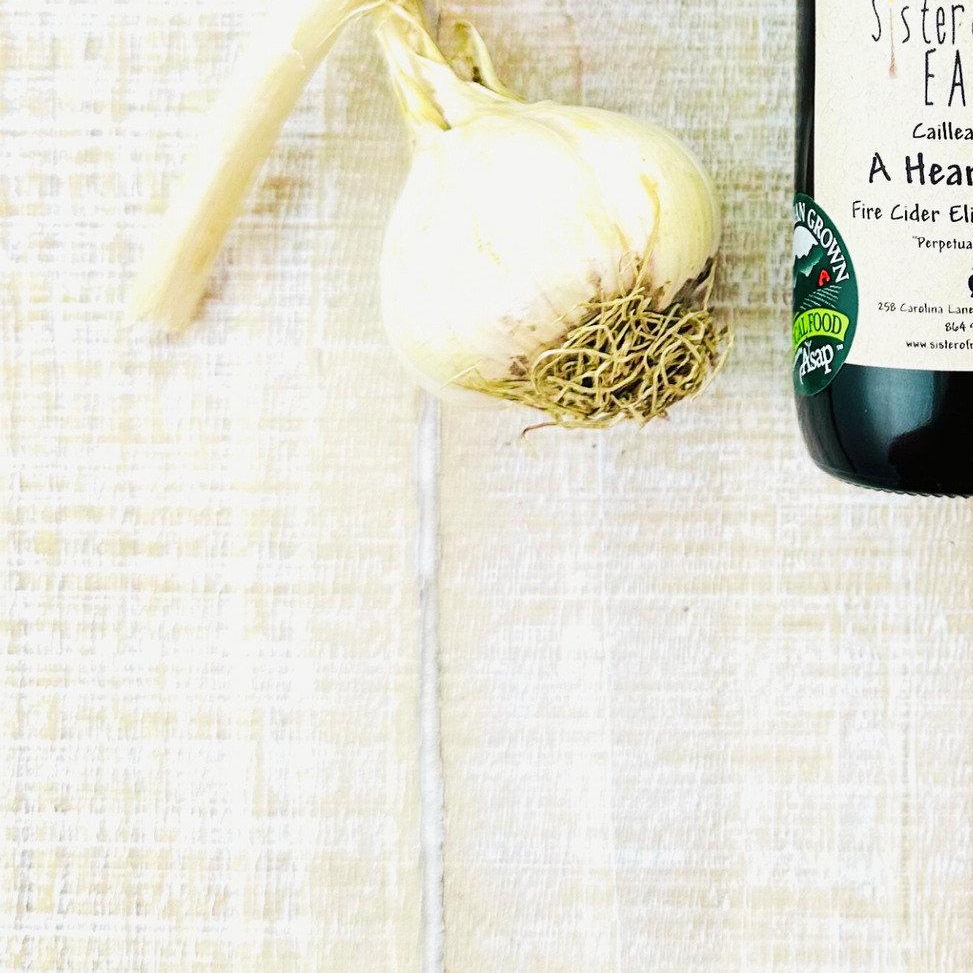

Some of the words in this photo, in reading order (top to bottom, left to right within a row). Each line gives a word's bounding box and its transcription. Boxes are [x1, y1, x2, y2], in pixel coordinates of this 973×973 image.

[868, 151, 892, 184] A
[852, 199, 883, 220] Fire
[890, 202, 941, 223] Cider
[807, 208, 850, 283] GROWN
[877, 301, 897, 313] 258
[899, 302, 944, 314] Carolina
[808, 312, 842, 334] FOOD
[944, 320, 967, 333] 864
